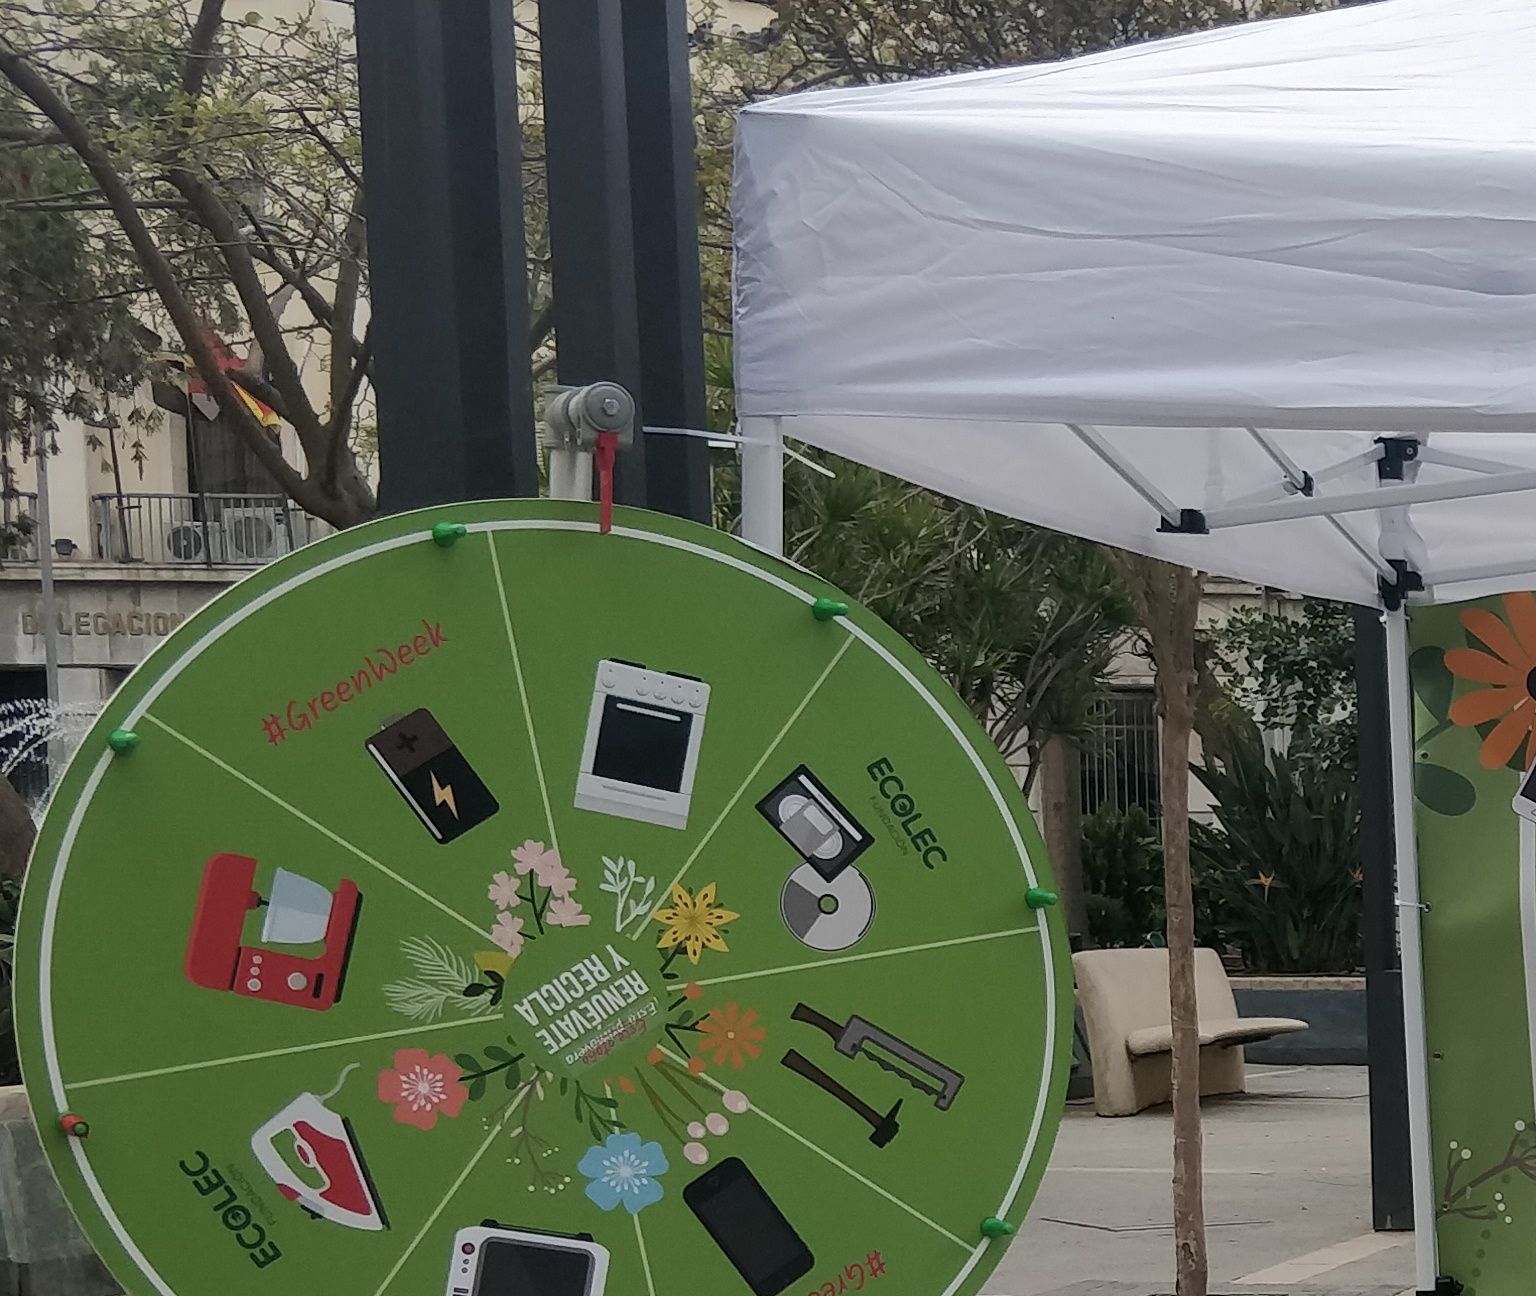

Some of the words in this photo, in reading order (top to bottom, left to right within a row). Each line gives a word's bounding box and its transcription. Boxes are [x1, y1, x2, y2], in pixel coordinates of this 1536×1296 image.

[20, 612, 186, 637] DLEGACION
[261, 619, 449, 746] #GreenWeek
[866, 757, 947, 870] ECOLEC
[513, 953, 612, 1027] RECICLA
[605, 943, 631, 972] Y
[535, 969, 651, 1056] RENUÉVATE
[179, 1150, 282, 1269] ECOLEC
